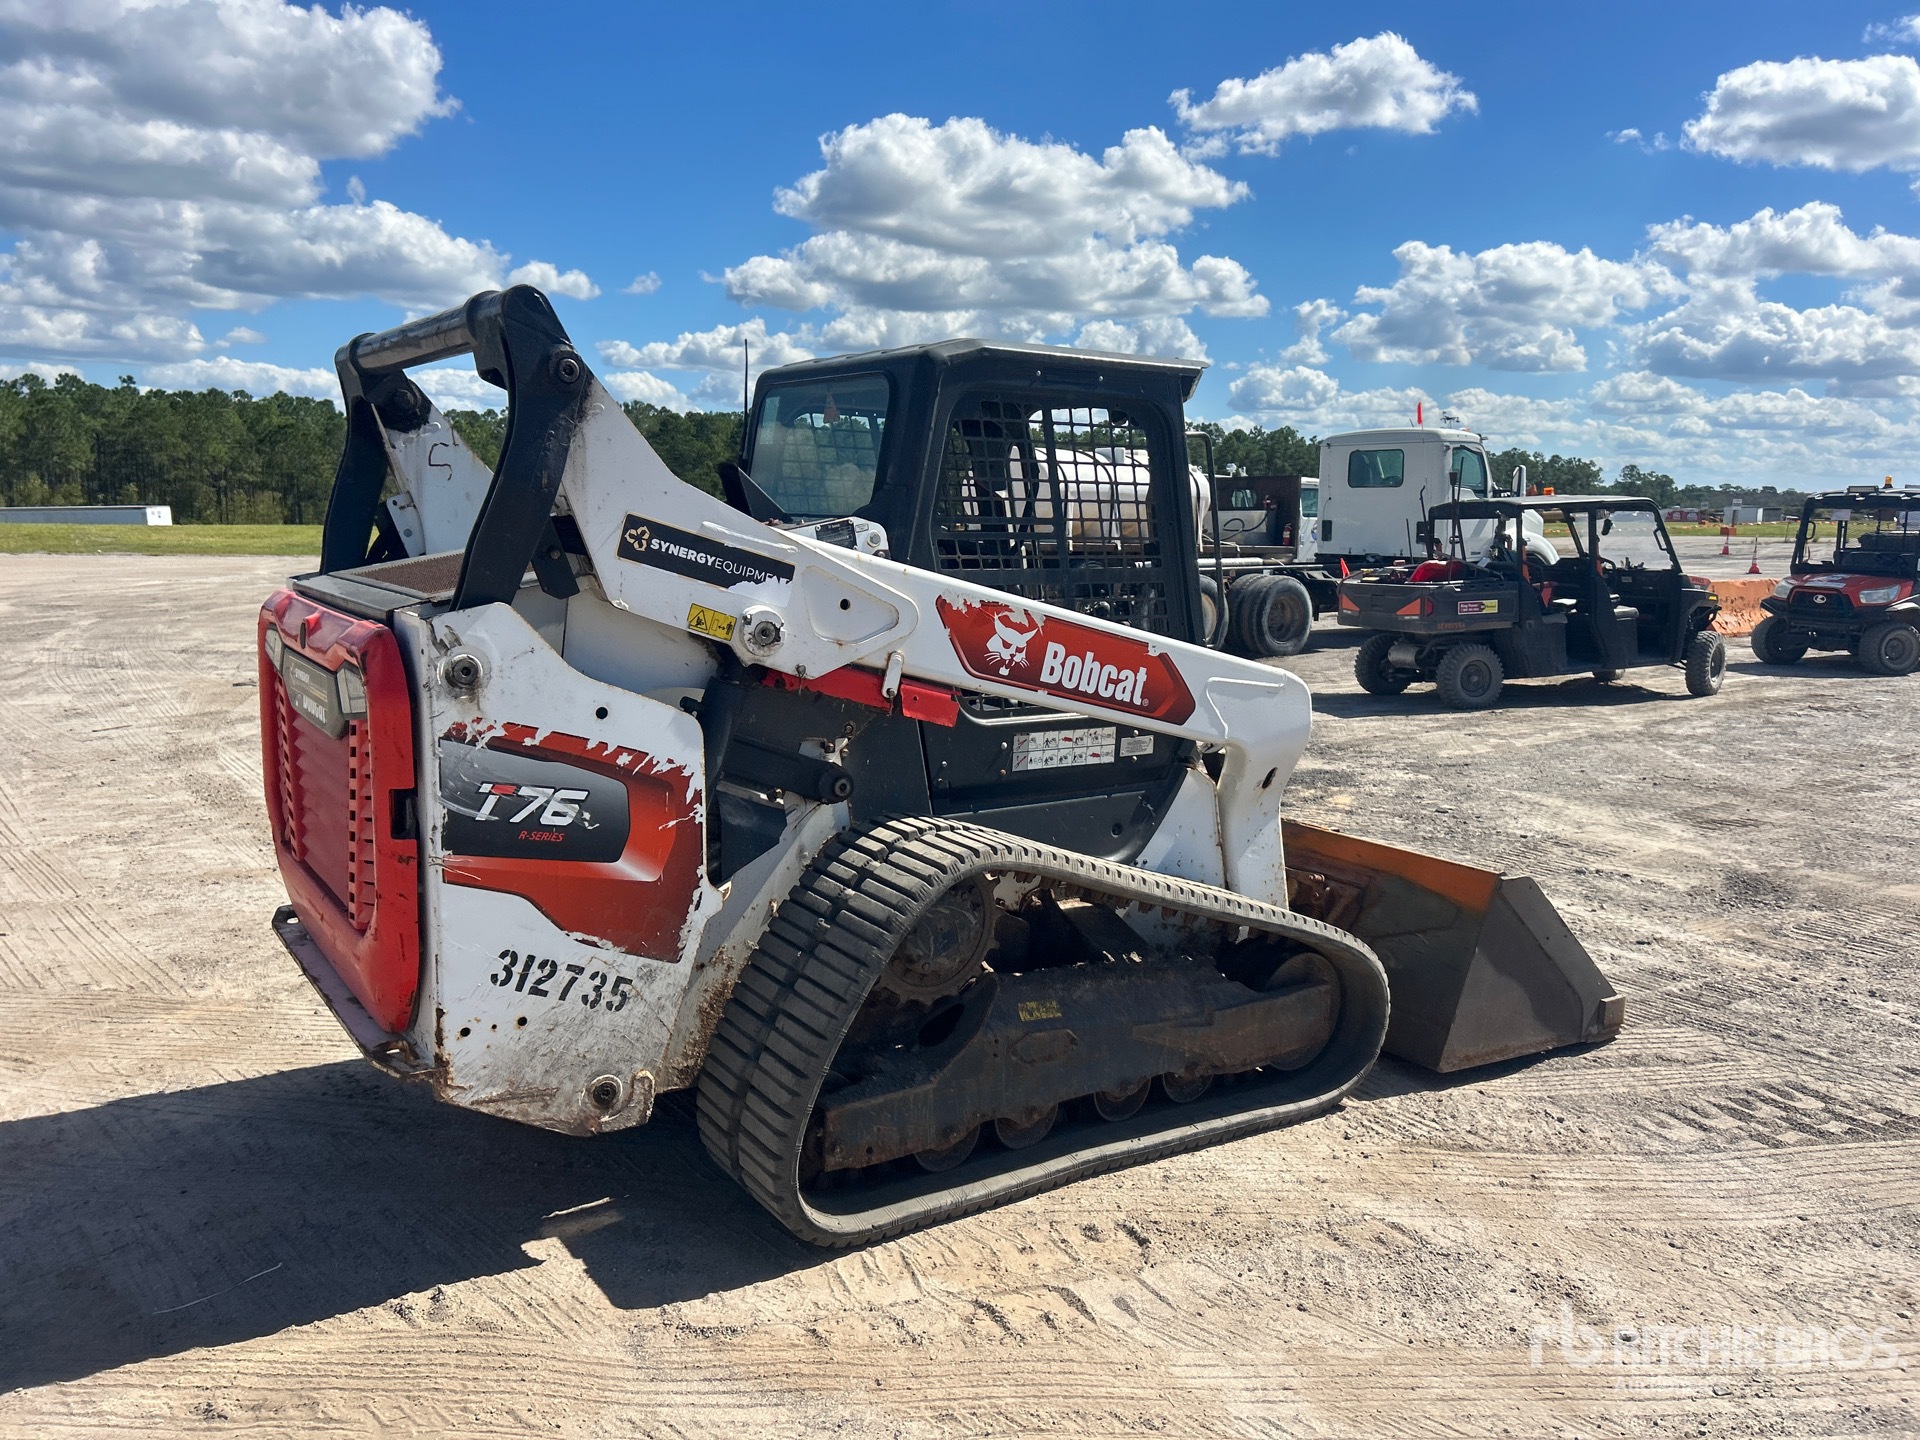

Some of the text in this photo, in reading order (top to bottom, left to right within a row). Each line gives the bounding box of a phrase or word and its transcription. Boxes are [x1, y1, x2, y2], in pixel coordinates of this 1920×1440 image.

[1040, 641, 1148, 706] Bobcat
[475, 783, 589, 826] T76
[518, 830, 565, 842] R-SERIES
[490, 949, 634, 1012] 312735
